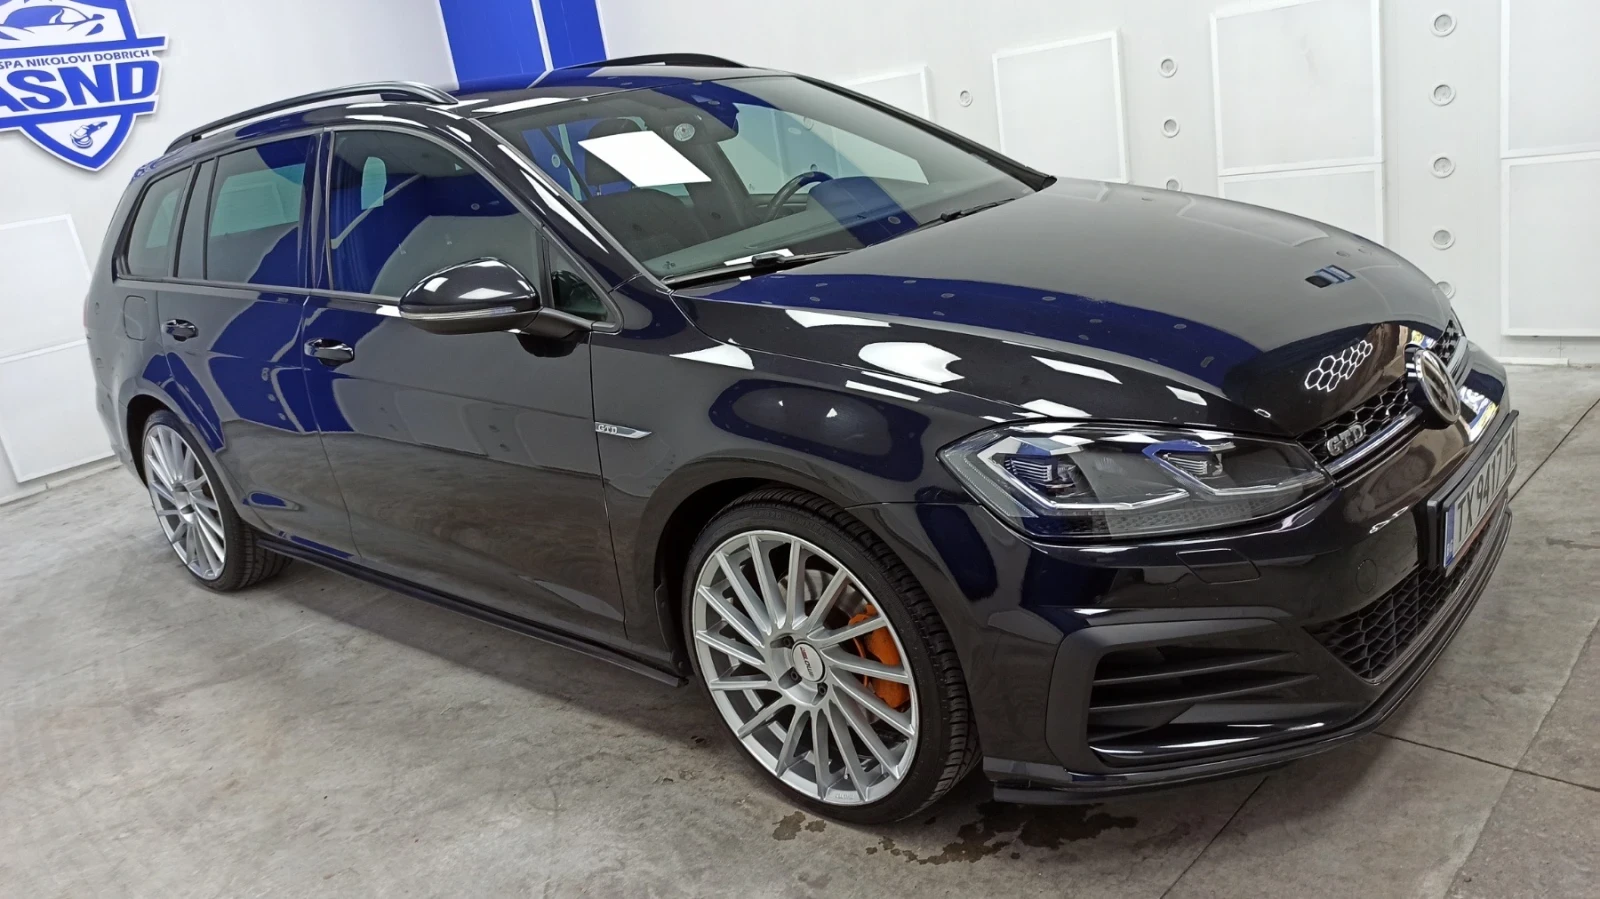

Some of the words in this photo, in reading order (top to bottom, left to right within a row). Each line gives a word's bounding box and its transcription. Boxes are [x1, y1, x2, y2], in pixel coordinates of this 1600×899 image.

[26, 54, 92, 68] NIKOLOVI
[95, 49, 150, 62] DOBRICH
[598, 424, 618, 434] GTD
[1326, 423, 1364, 457] GTD
[1457, 485, 1475, 542] TX
[1476, 445, 1503, 518] 9417
[1504, 425, 1516, 475] TA
